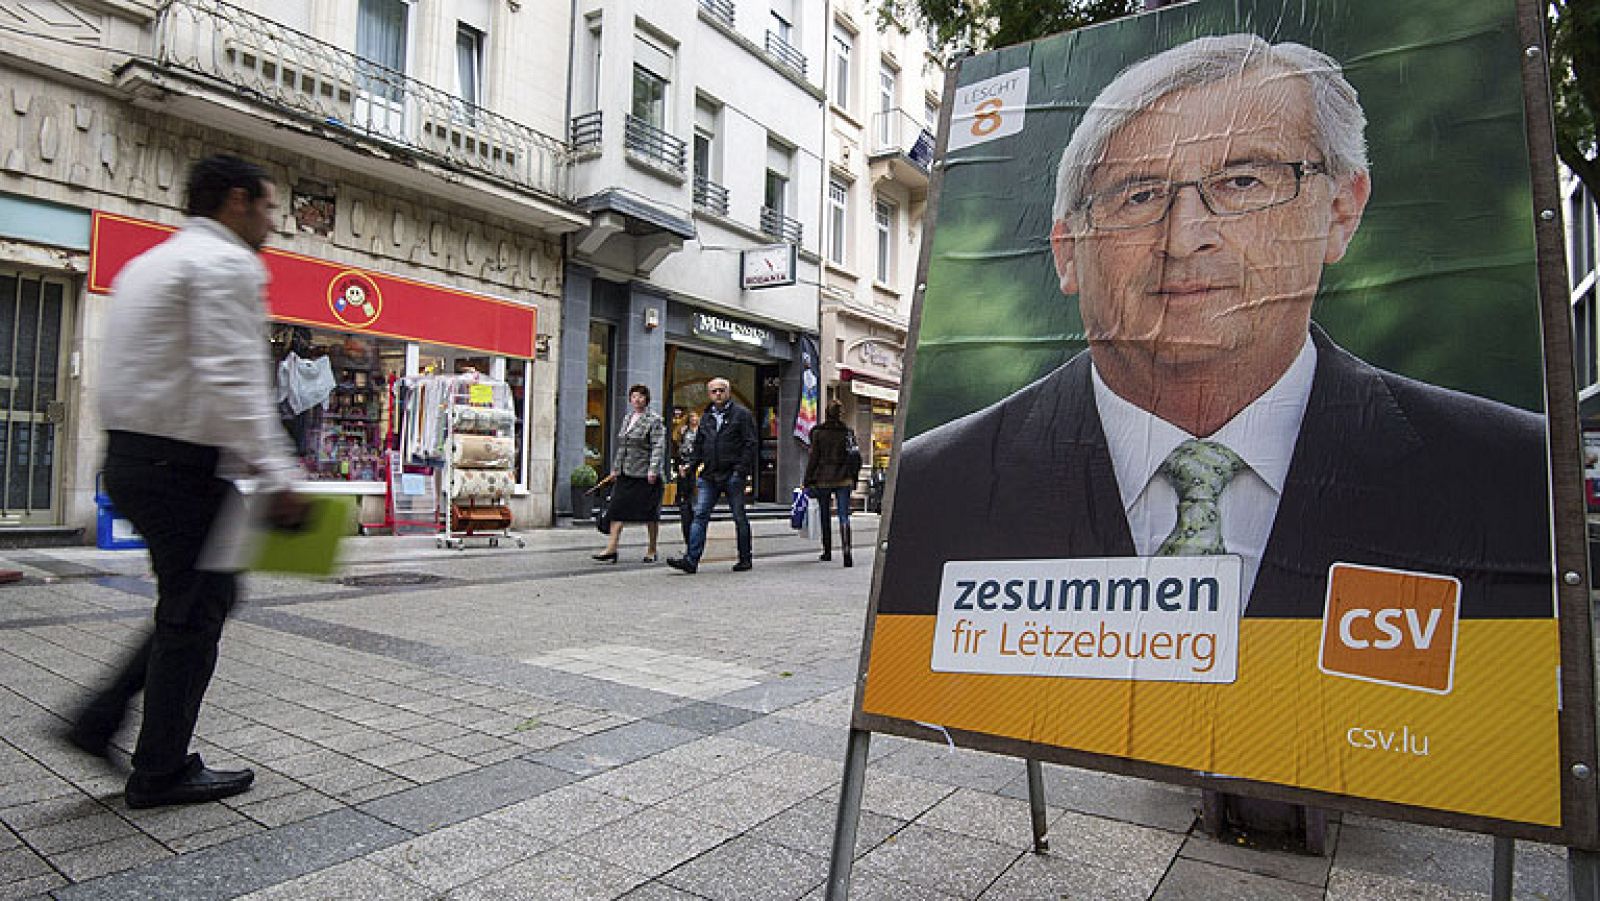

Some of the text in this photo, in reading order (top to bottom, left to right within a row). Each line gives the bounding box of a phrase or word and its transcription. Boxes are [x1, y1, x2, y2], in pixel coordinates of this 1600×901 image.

[971, 97, 1003, 136] 8
[953, 577, 1219, 612] zesummen
[952, 619, 1217, 672] fir Lëtzebuerg
[1339, 608, 1442, 650] CSV
[1347, 725, 1429, 756] csv.lu
